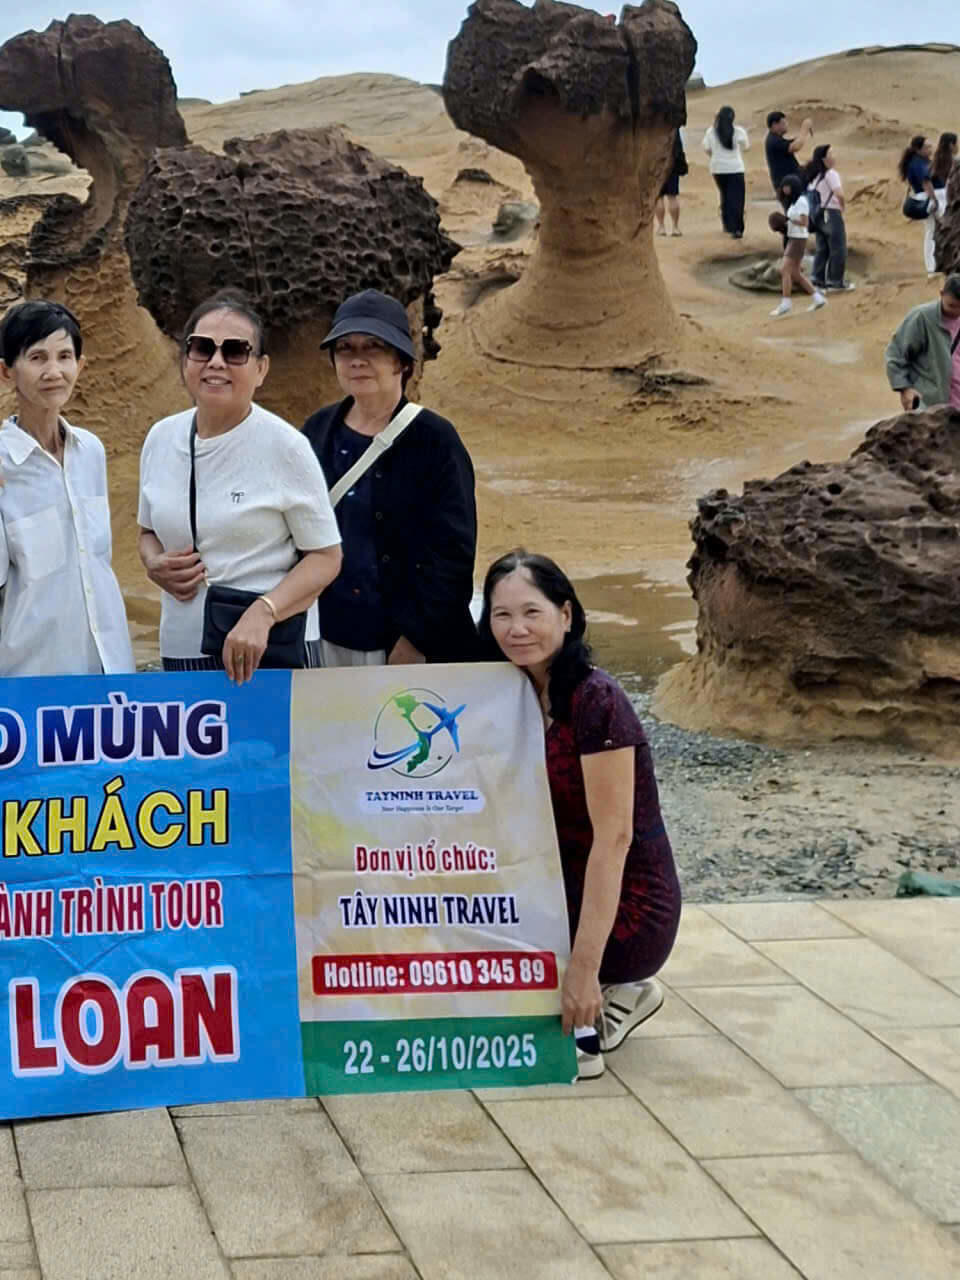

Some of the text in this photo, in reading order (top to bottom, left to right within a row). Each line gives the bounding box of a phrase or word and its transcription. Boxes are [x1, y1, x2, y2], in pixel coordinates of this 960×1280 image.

[42, 694, 224, 764] MỪNG
[365, 790, 479, 801] TAYNINH TRAVEL
[3, 777, 229, 857] KHÁCH
[356, 839, 496, 877] Đơn vị tổ chức:
[61, 879, 143, 936] TRÌNH
[150, 881, 222, 929] TOUR
[340, 891, 520, 926] TÂY NINH TRAVEL
[324, 958, 546, 988] Hotline: 09610 345 89
[14, 972, 235, 1070] LOAN
[343, 1033, 538, 1075] 22 - 26/10/2025
